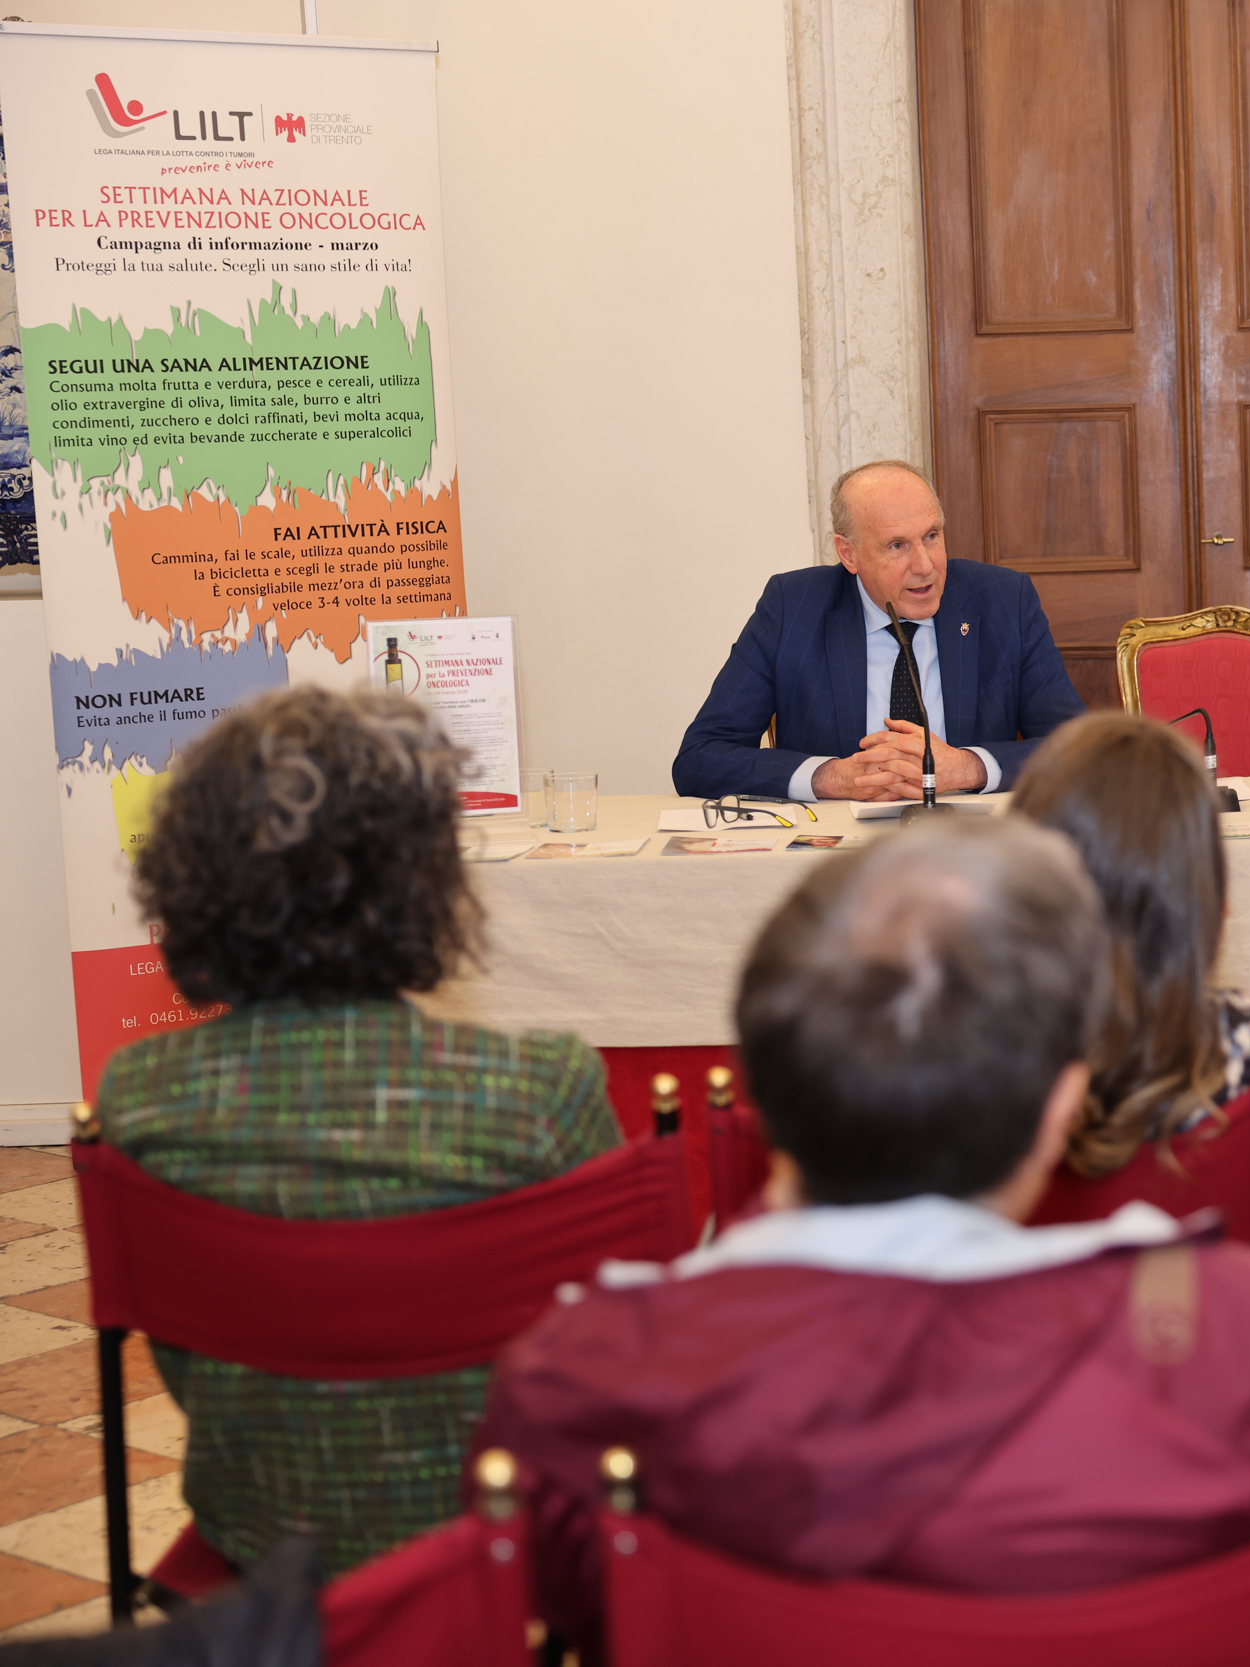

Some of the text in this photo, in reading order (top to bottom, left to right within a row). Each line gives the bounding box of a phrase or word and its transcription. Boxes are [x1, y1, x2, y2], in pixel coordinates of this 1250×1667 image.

[172, 109, 254, 142] LILT
[309, 112, 352, 124] SEZIONE
[309, 123, 373, 135] PROVINCIALE
[310, 134, 363, 146] DI TRENTO
[113, 148, 146, 156] ITALIANA
[194, 150, 225, 158] CONTRO
[160, 158, 274, 177] prevenire è vivere
[99, 185, 370, 207] SETTIMANA NAZIONALE
[34, 208, 426, 231] PER LA PREVENZIONE ONCOLOGICA
[96, 235, 379, 254] Campagna di informazione marzo
[54, 257, 412, 276] Proteggi la tua salute. Scegli un sano stile di vita!
[47, 355, 370, 375] SEGUI UNA SANA ALIMENTAZIONE
[48, 374, 420, 393] Consuma molta frutta e verdura, pesce e cereali, utilizza
[50, 392, 381, 412] olio extravergine di oliva, limita sale, burro e altri
[52, 409, 424, 430] condimenti, zucchero e dolci raffinati, bevi molta acqua,
[53, 425, 412, 448] limita vino ed evita bevande zuccherate e superalcolici
[273, 519, 448, 542] FAI ATTIVITÀ FISICA
[150, 539, 448, 565] Cammina, fai le scale, utilizza quando possibile
[193, 556, 449, 581] la bicicletta e scegli le strade più lunghe.
[212, 573, 451, 597] È consigliabile mezz'ora di passeggiata
[272, 591, 452, 611] veloce 3-4 volte la settimana
[425, 657, 503, 669] SETTIMANA NAZIONALE
[425, 667, 494, 680] per la PREVENZIONE
[426, 679, 470, 689] ONCOLOGICA
[74, 686, 206, 710] NON FUMARE
[76, 715, 110, 728] Evita
[115, 711, 154, 726] anche
[158, 709, 167, 722] il
[172, 708, 206, 721] fumo
[129, 960, 164, 976] LEGA
[120, 1015, 141, 1029] tel.
